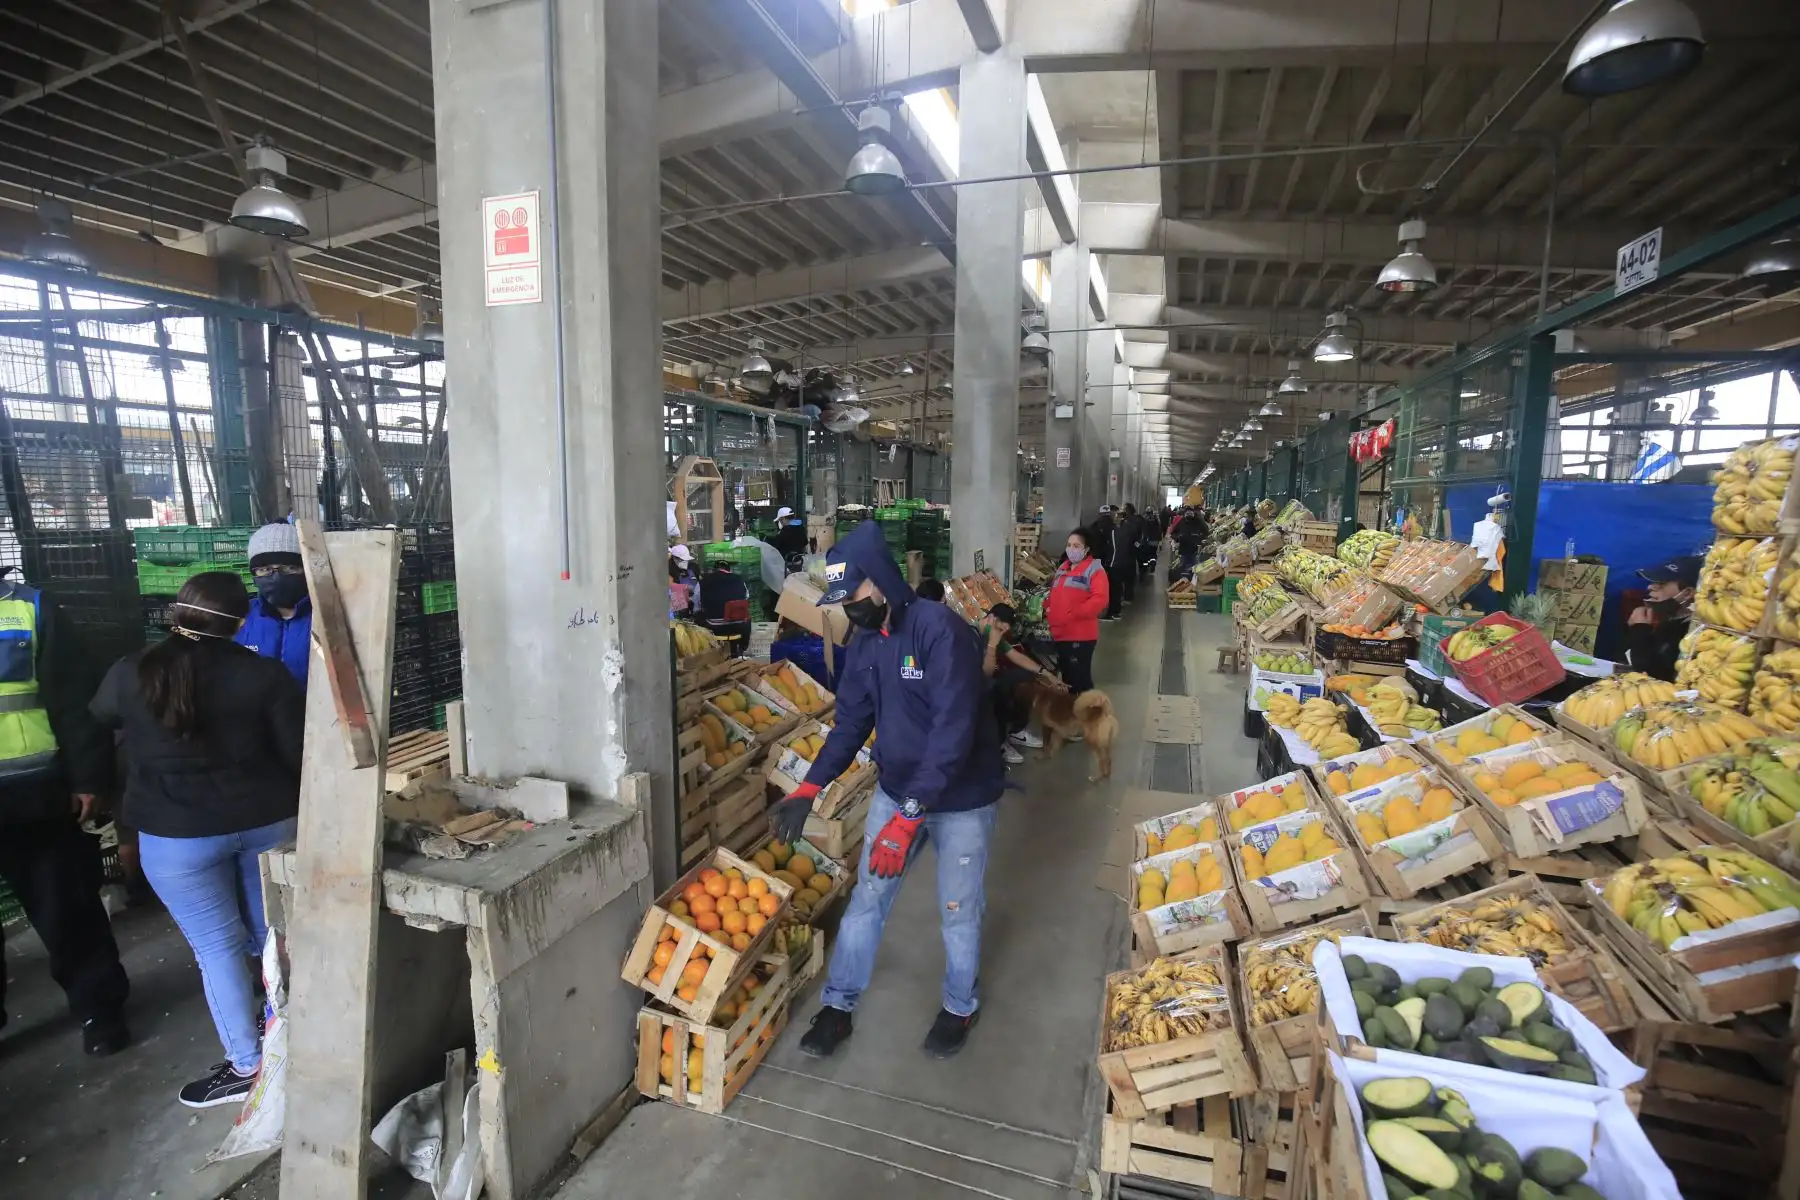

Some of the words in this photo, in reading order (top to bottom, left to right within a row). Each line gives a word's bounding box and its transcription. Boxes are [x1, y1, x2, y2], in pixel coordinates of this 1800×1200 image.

[1619, 237, 1657, 276] A4-02
[501, 276, 514, 284] LUZ
[515, 275, 525, 283] DE
[492, 284, 535, 295] EMERGENCIA
